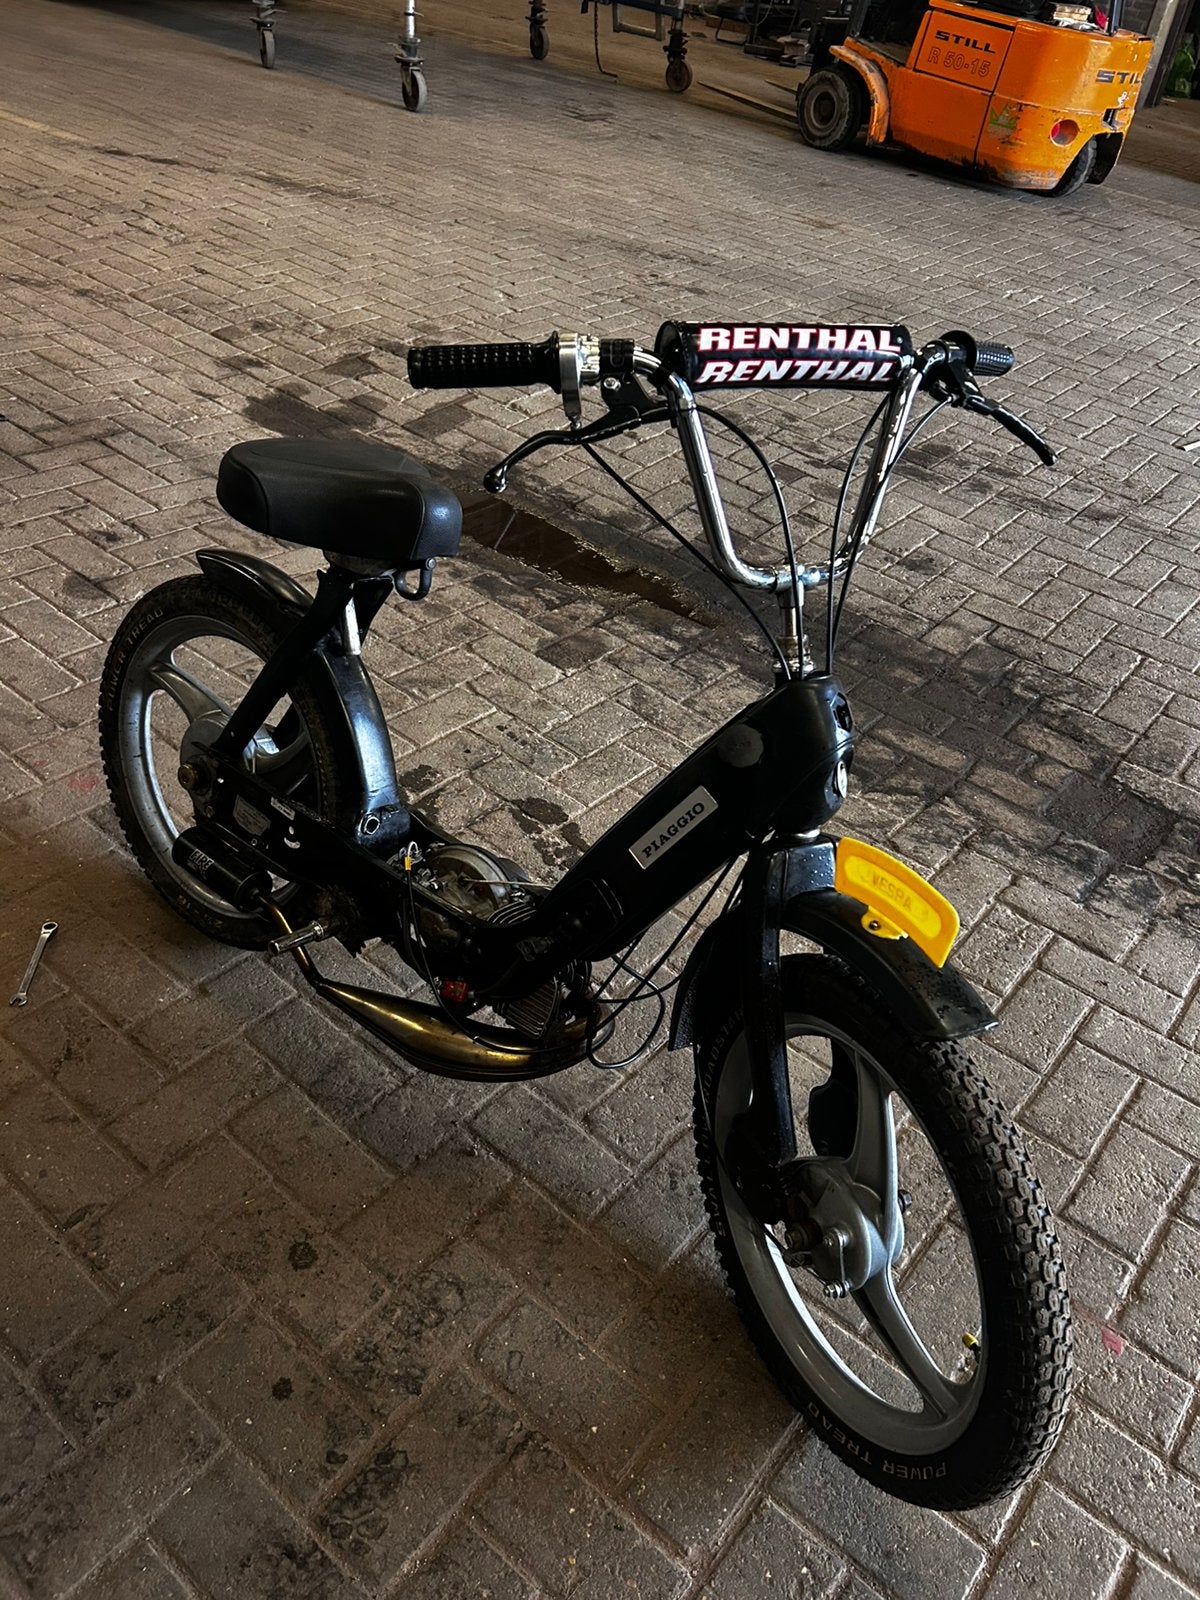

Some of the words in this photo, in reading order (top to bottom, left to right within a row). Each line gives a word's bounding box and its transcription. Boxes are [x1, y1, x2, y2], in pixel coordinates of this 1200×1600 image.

[935, 30, 996, 54] STILL
[928, 46, 942, 65] R
[943, 51, 991, 77] 50-15
[698, 327, 901, 352] RENTHAL
[696, 359, 897, 384] RENTHAL
[641, 802, 705, 858] PIAGGIO
[871, 870, 912, 912] VESPA
[808, 1401, 873, 1466] TREAD
[882, 1460, 947, 1480] POWER
